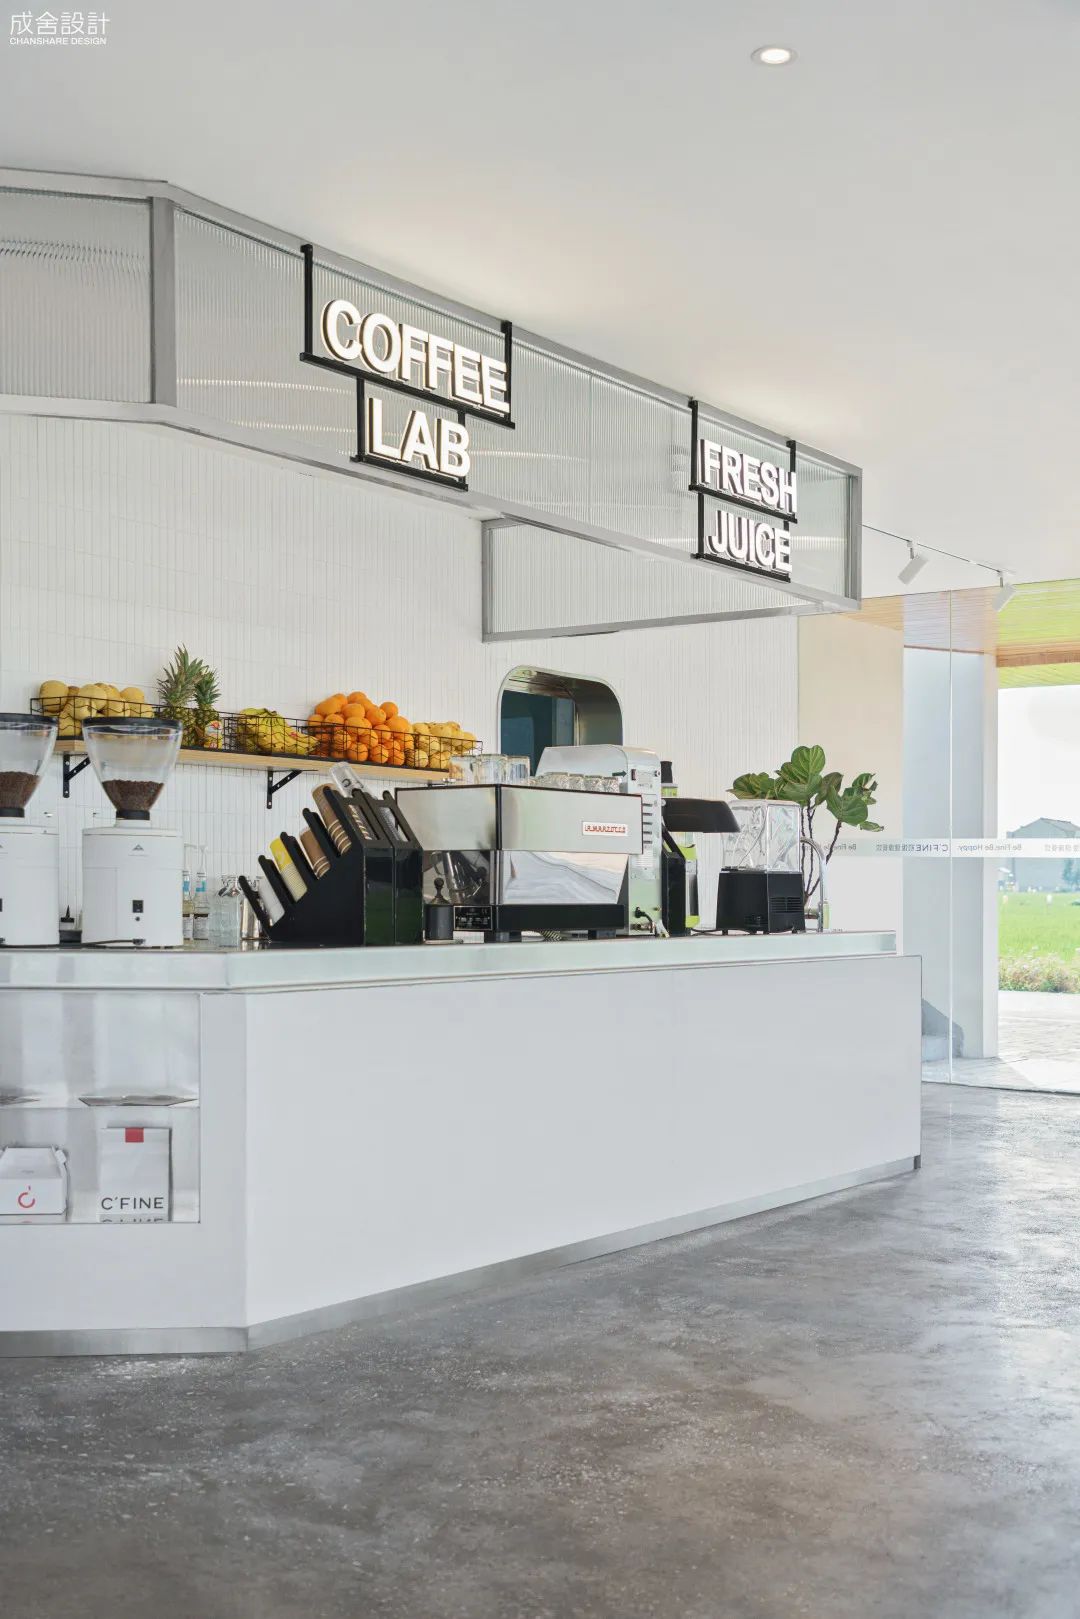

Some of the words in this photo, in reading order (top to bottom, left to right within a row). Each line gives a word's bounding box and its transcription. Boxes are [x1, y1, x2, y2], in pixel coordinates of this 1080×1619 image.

[321, 299, 510, 415] COFFEE
[366, 397, 471, 478] LAB
[698, 438, 797, 513] FRESH
[706, 510, 792, 574] JUICE
[101, 1197, 164, 1210] C'FINE
